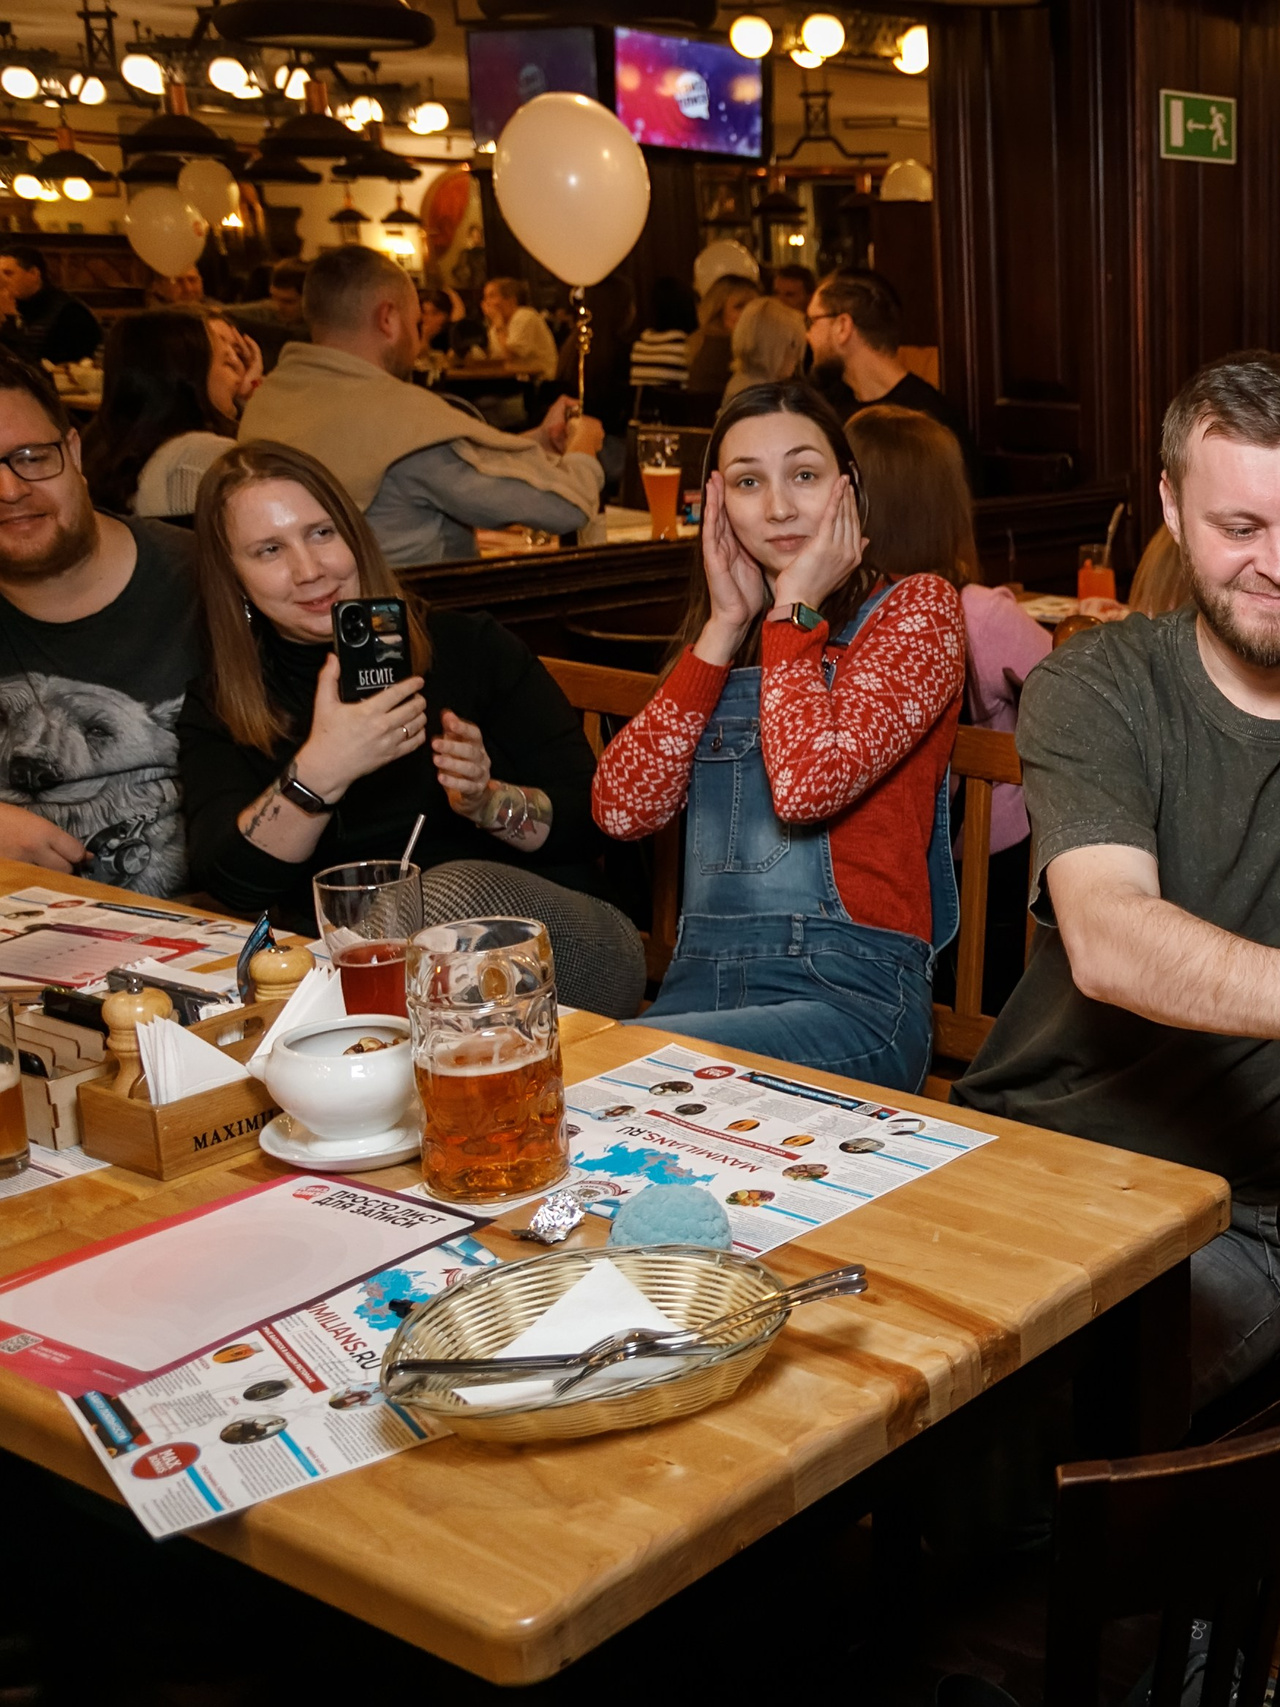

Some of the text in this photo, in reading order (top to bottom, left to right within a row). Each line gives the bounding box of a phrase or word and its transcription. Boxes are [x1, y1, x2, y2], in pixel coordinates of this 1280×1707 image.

[358, 667, 395, 686] БЕСИТЕ
[615, 1125, 763, 1174] MAXIMILIANS.RU
[312, 1196, 420, 1229] ДЛЯ ЗАПИСИ
[330, 1190, 399, 1212] ПРОСТО
[394, 1208, 447, 1225] ЛИСТ
[307, 1302, 382, 1371] IMILIANS.RU
[158, 1448, 182, 1471] MAX
